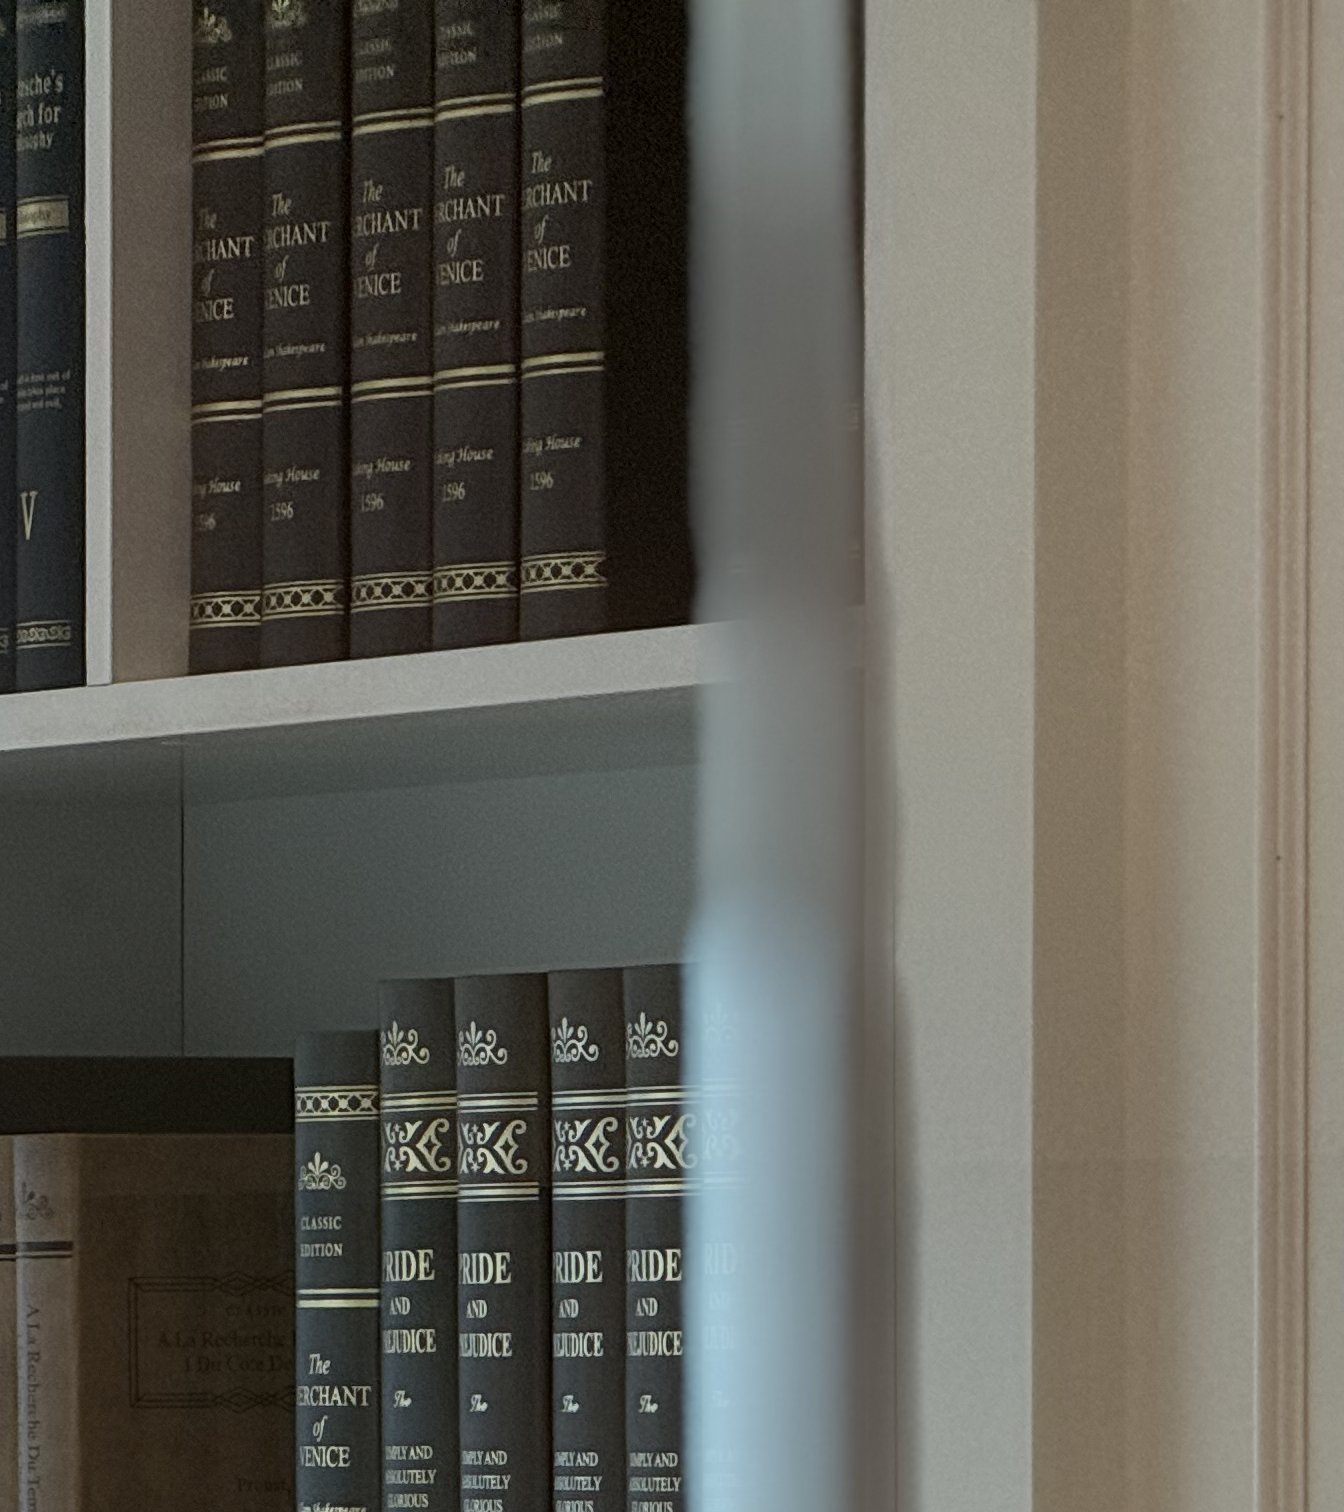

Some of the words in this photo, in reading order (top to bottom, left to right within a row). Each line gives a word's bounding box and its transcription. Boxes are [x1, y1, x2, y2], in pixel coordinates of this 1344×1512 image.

[532, 151, 551, 173] The
[444, 166, 464, 189] The
[362, 180, 383, 202] The
[272, 193, 291, 216] The
[534, 216, 548, 241] of
[447, 231, 461, 255] of
[365, 245, 378, 268] of
[274, 258, 289, 281] of
[547, 435, 582, 451] House
[458, 446, 493, 462] House
[285, 466, 320, 481] House
[376, 458, 411, 473] House
[530, 472, 553, 491] 1596
[270, 502, 293, 521] 1596
[390, 1297, 410, 1315] AND
[466, 1300, 487, 1318] AND
[559, 1299, 579, 1318] AND
[635, 1298, 658, 1316] AND
[309, 1353, 331, 1375] The
[313, 1416, 328, 1442] of
